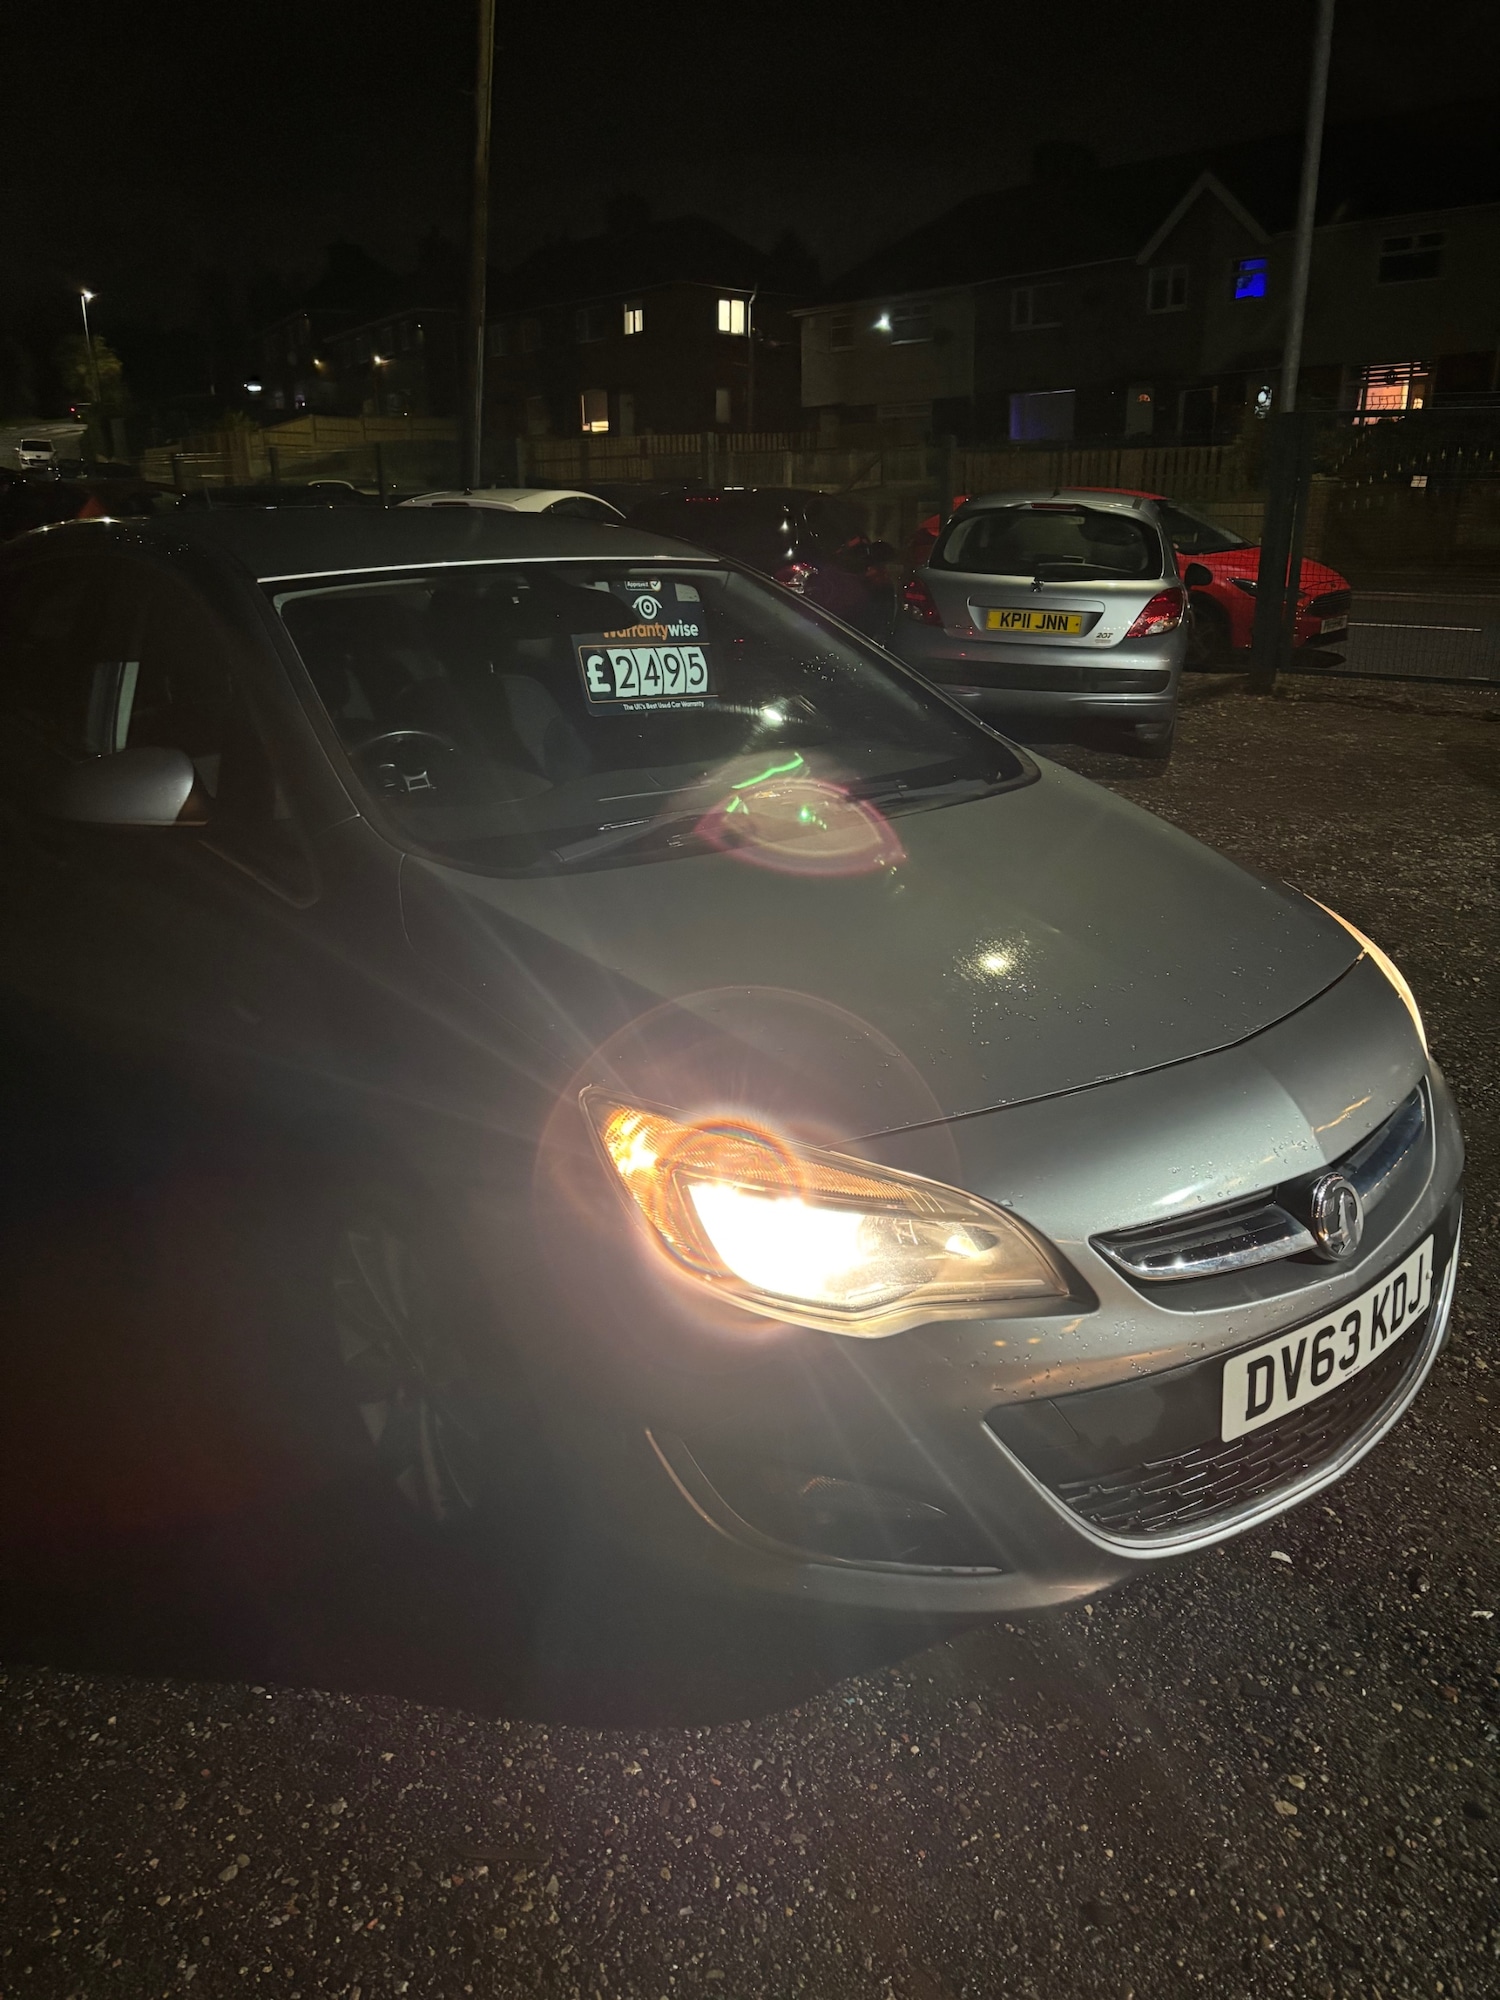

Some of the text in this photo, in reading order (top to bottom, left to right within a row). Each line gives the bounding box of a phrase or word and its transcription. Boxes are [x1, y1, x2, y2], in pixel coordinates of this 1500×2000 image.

[1000, 612, 1068, 631] KP11 JNN
[586, 653, 705, 693] £2495
[646, 702, 658, 710] Best
[658, 701, 671, 709] Used
[1245, 1252, 1424, 1421] DV63 KDJ
